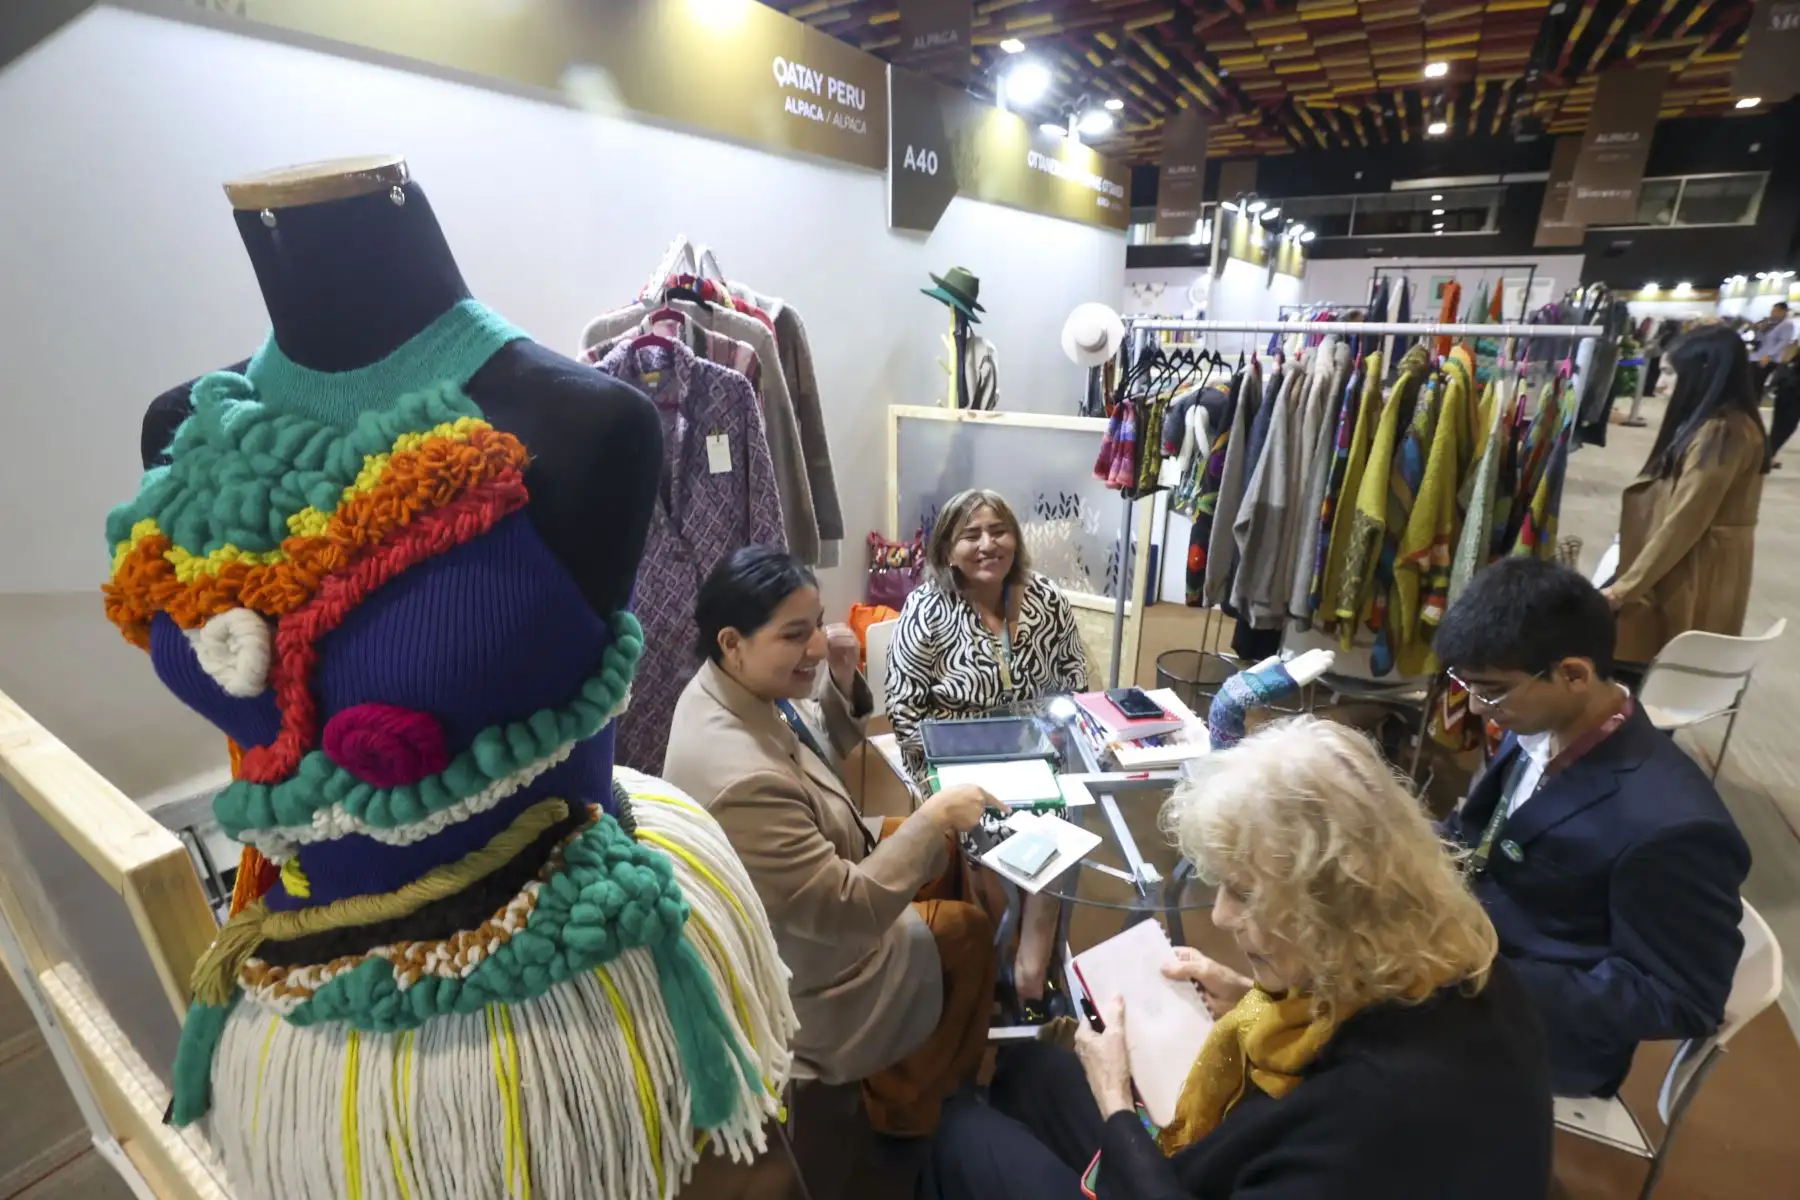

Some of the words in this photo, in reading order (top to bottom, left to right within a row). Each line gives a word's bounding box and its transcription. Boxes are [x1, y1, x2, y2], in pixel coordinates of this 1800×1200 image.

[772, 55, 824, 96] QATAY
[827, 76, 866, 111] PERU
[784, 95, 824, 122] ALPACA
[832, 112, 867, 135] ALPACA
[903, 144, 938, 176] A40
